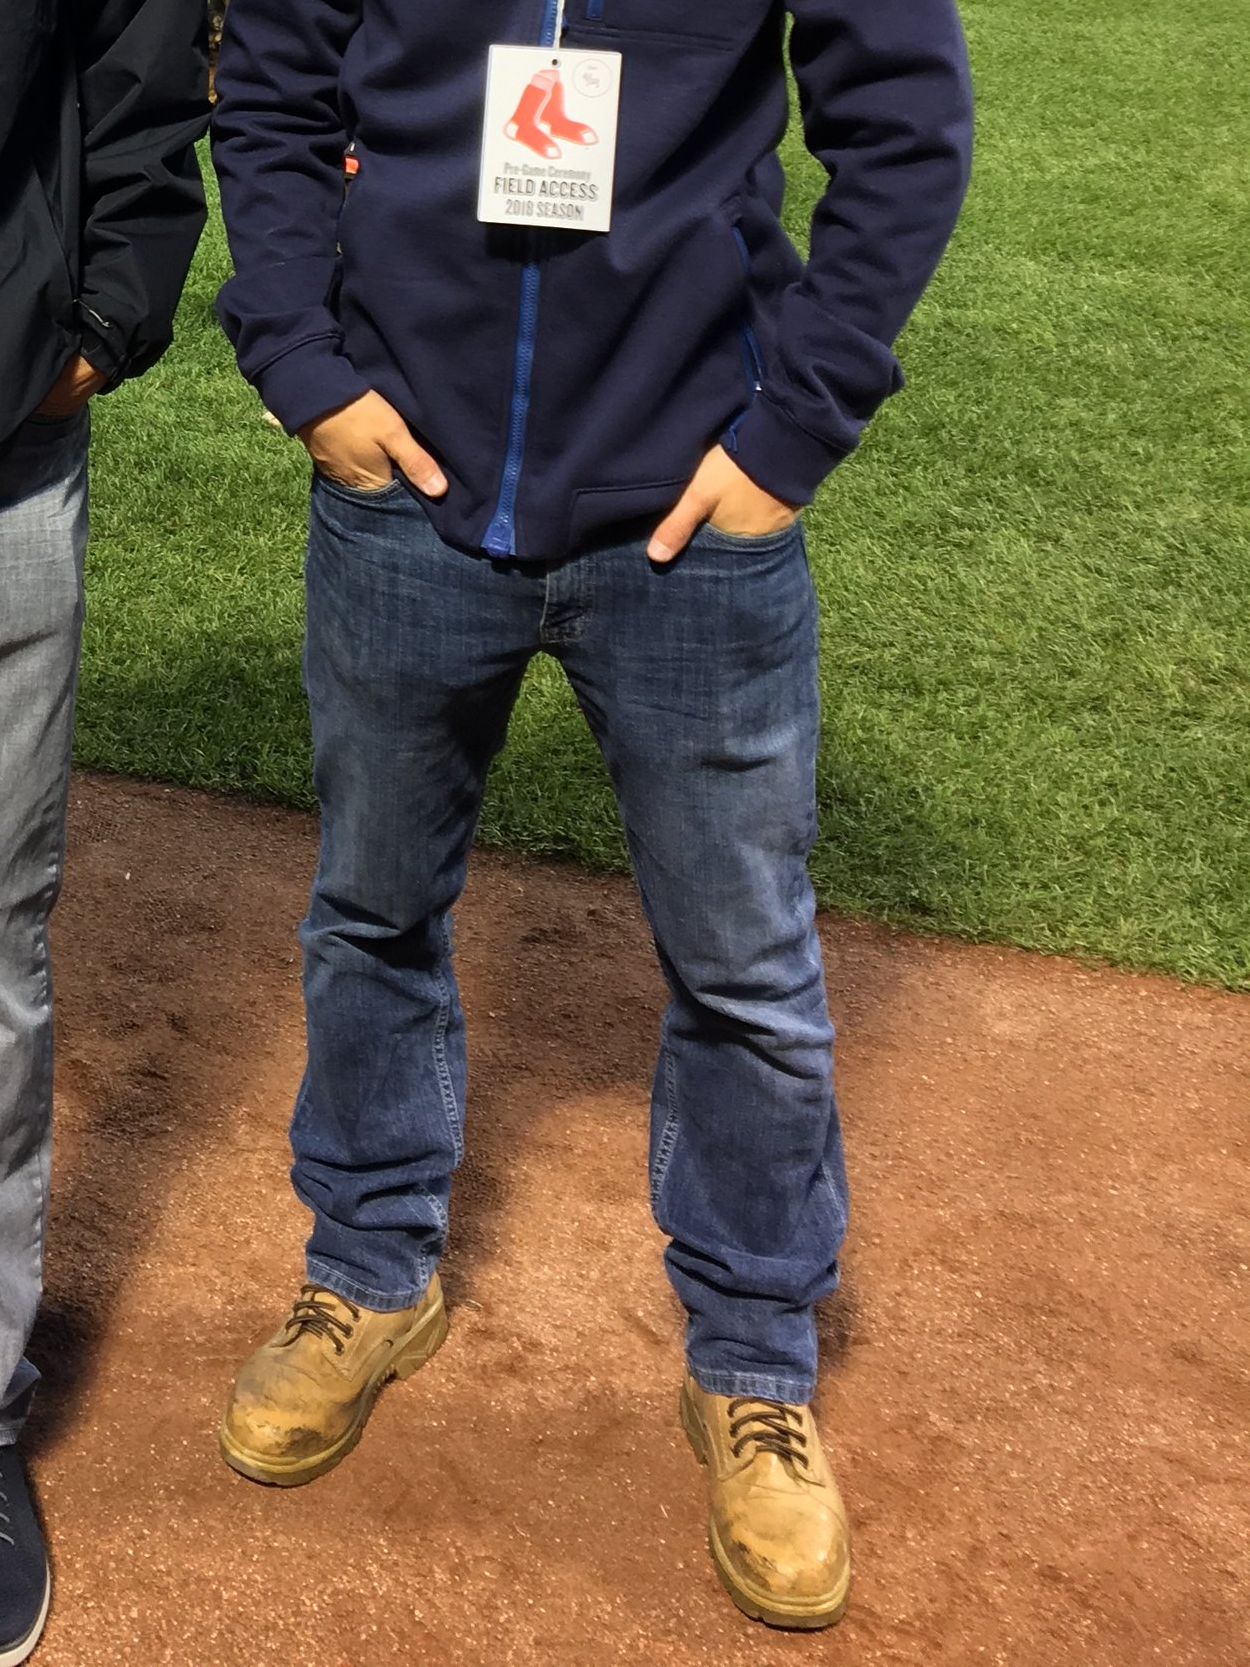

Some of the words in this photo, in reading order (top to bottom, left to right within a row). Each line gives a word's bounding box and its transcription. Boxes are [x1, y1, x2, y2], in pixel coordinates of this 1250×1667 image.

[494, 176, 535, 195] FIELD
[538, 180, 599, 201] ACCESS
[505, 199, 535, 217] 2018
[536, 201, 585, 220] SEASON
